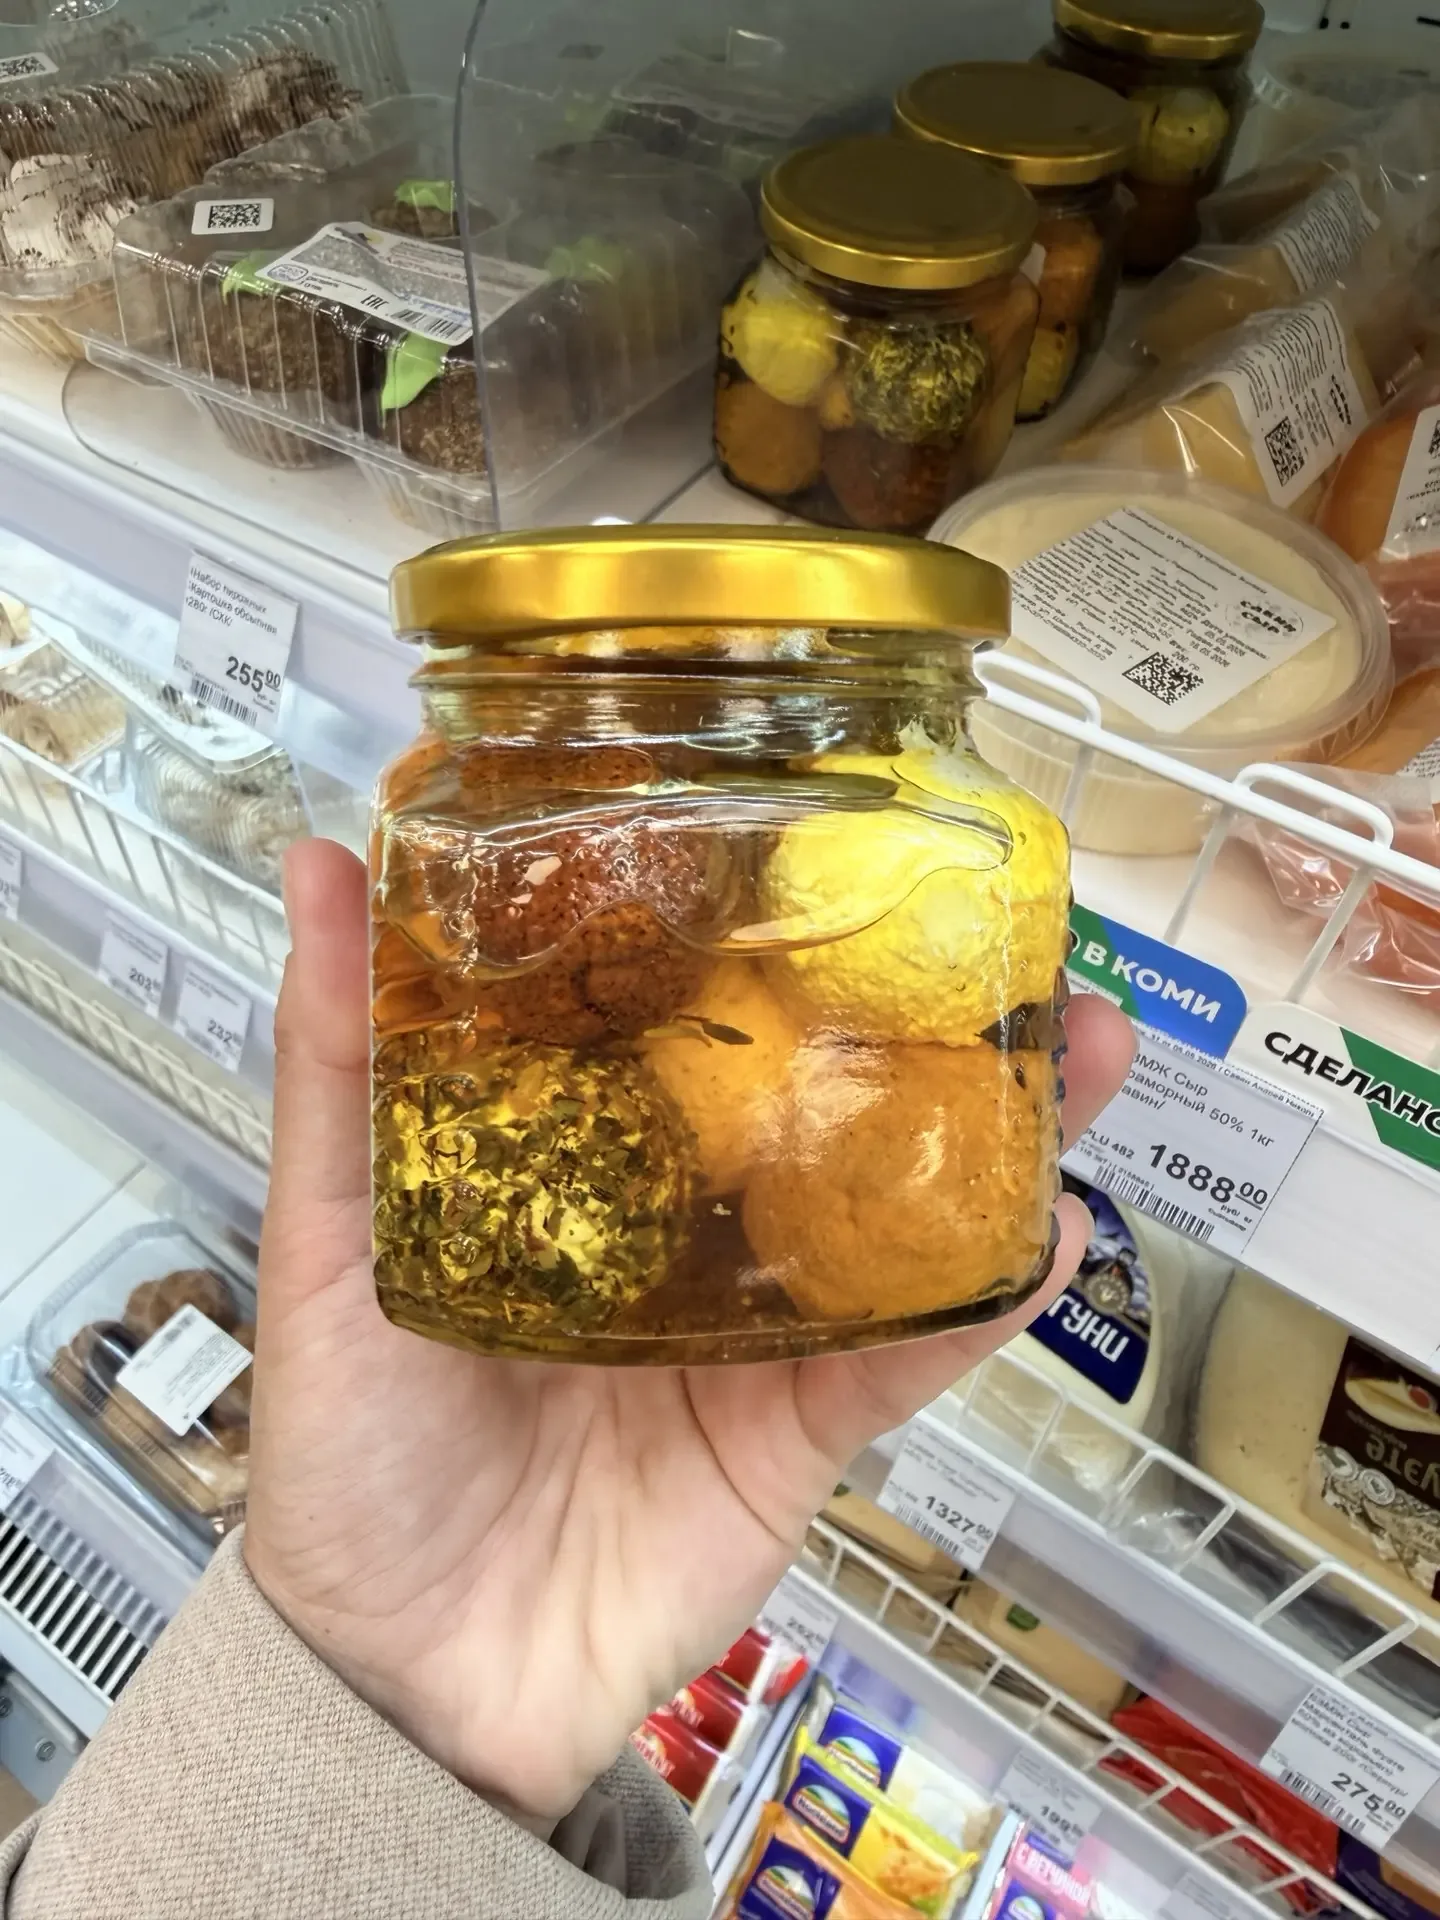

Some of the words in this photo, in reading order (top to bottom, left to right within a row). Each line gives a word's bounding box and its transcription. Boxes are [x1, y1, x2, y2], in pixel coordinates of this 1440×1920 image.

[225, 655, 265, 693] 255
[1082, 940, 1108, 967] В
[1110, 954, 1222, 1024] КОМИ
[1174, 1071, 1209, 1097] Сыр
[1209, 1107, 1244, 1134] 50%
[1111, 1141, 1136, 1160] 482
[1149, 1142, 1237, 1204] 1888
[925, 1495, 976, 1535] 1327
[1330, 1772, 1385, 1813] 275
